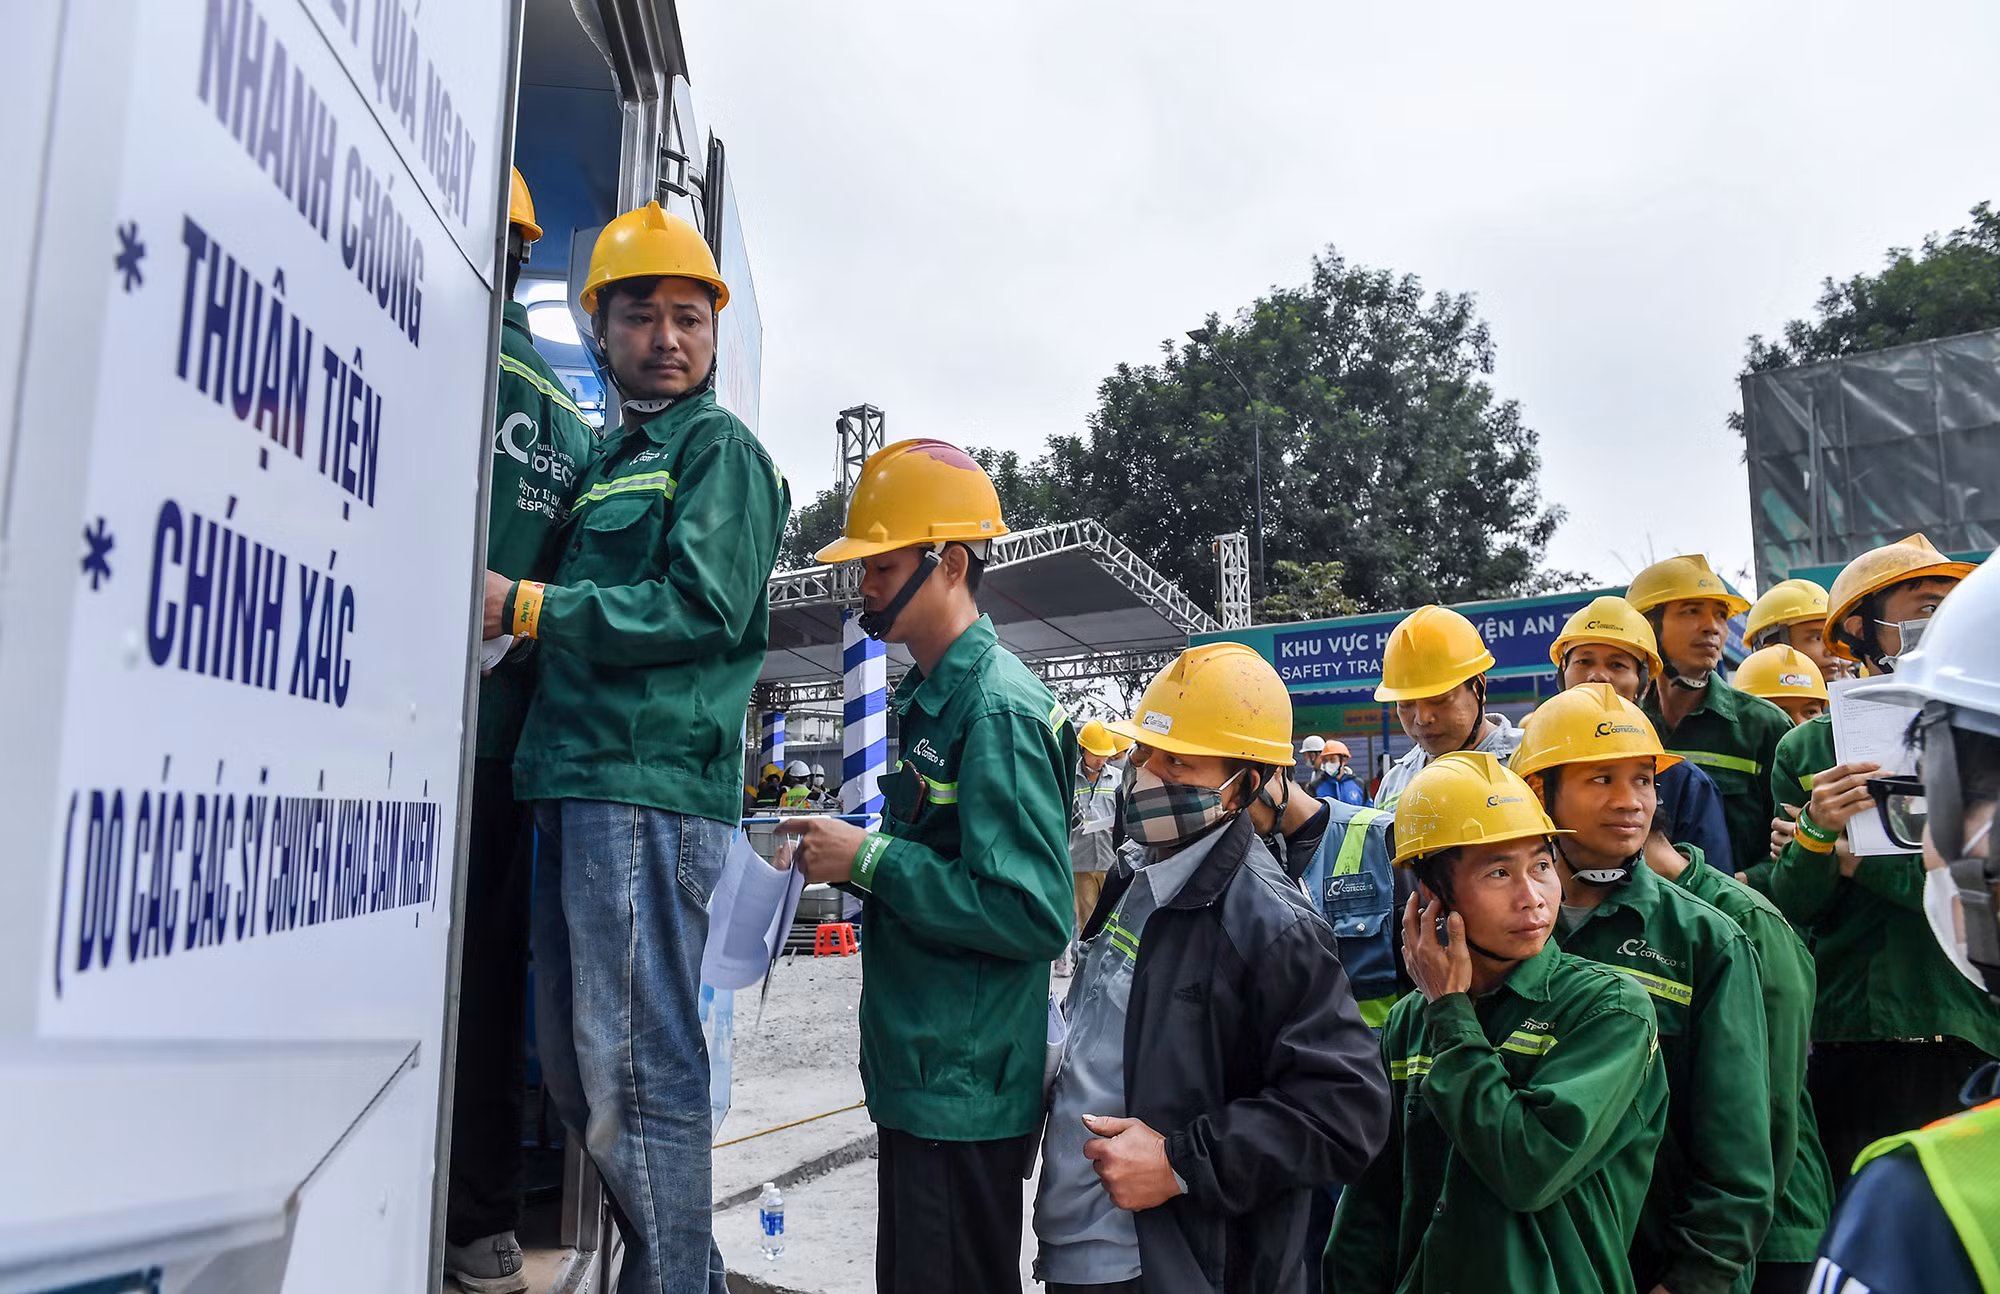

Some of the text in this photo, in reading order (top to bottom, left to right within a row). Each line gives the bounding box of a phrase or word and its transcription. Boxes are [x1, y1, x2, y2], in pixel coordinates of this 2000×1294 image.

[198, 0, 424, 348] NHANH CHÓNG
[176, 214, 382, 521] THUẬN TIỆN
[147, 494, 354, 708] CHÍNH XÁC
[1281, 662, 1342, 680] SAFETY
[1282, 639, 1321, 658] KHU
[1328, 633, 1369, 656] VỰC
[1522, 614, 1555, 636] AN
[128, 754, 185, 964] CÁC
[184, 759, 234, 951] BÁC
[266, 769, 334, 936] CHUYÊN
[331, 798, 371, 921] KHOA
